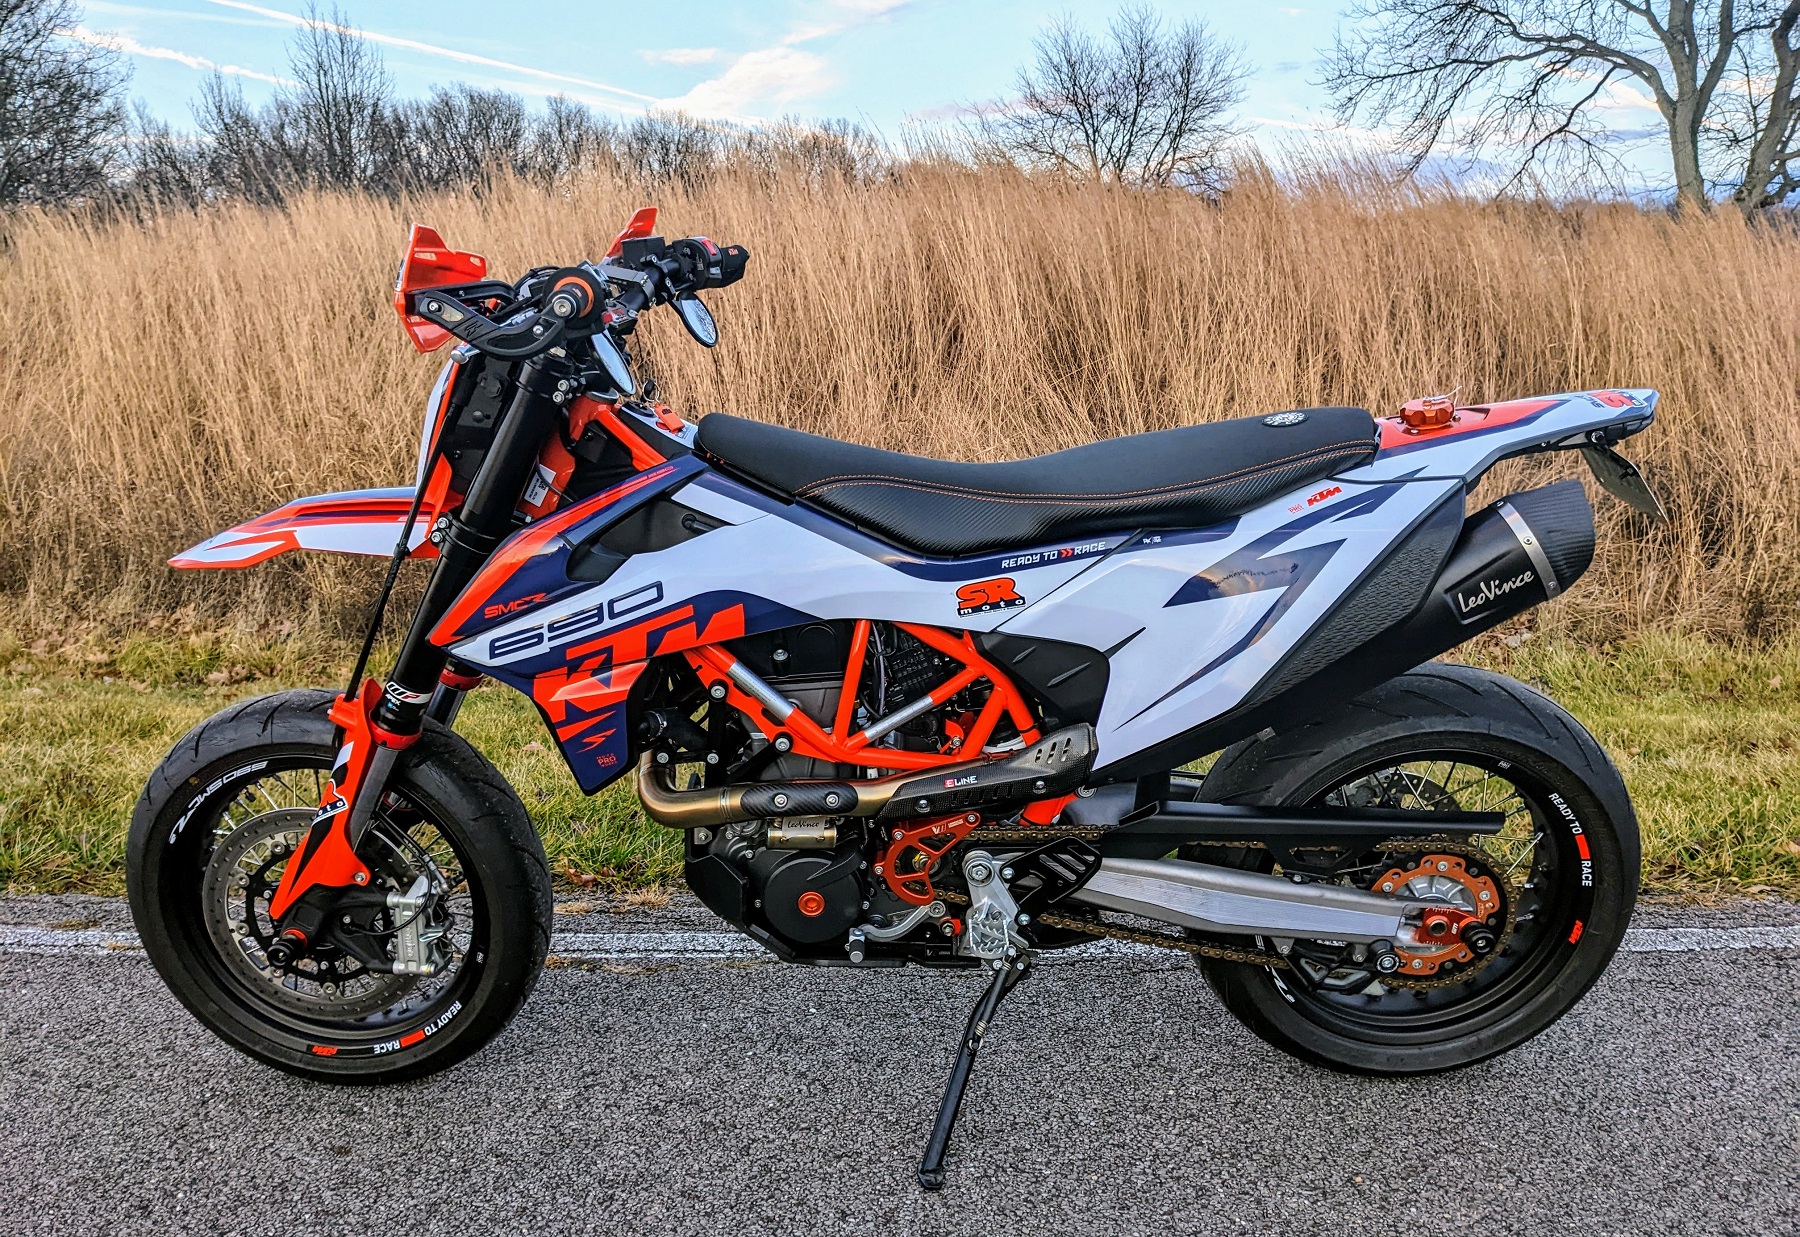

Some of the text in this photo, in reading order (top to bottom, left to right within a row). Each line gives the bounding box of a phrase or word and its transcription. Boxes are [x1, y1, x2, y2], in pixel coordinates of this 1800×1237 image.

[1306, 486, 1342, 506] KTM
[1001, 541, 1106, 569] READY TO RACE
[956, 577, 1021, 609] SR
[960, 600, 1024, 615] moto
[1457, 570, 1535, 613] LeoVince
[489, 580, 664, 660] 690
[533, 603, 745, 723] KTM
[1549, 793, 1593, 887] READY TO RACE
[373, 1000, 462, 1054] READY TO RACE
